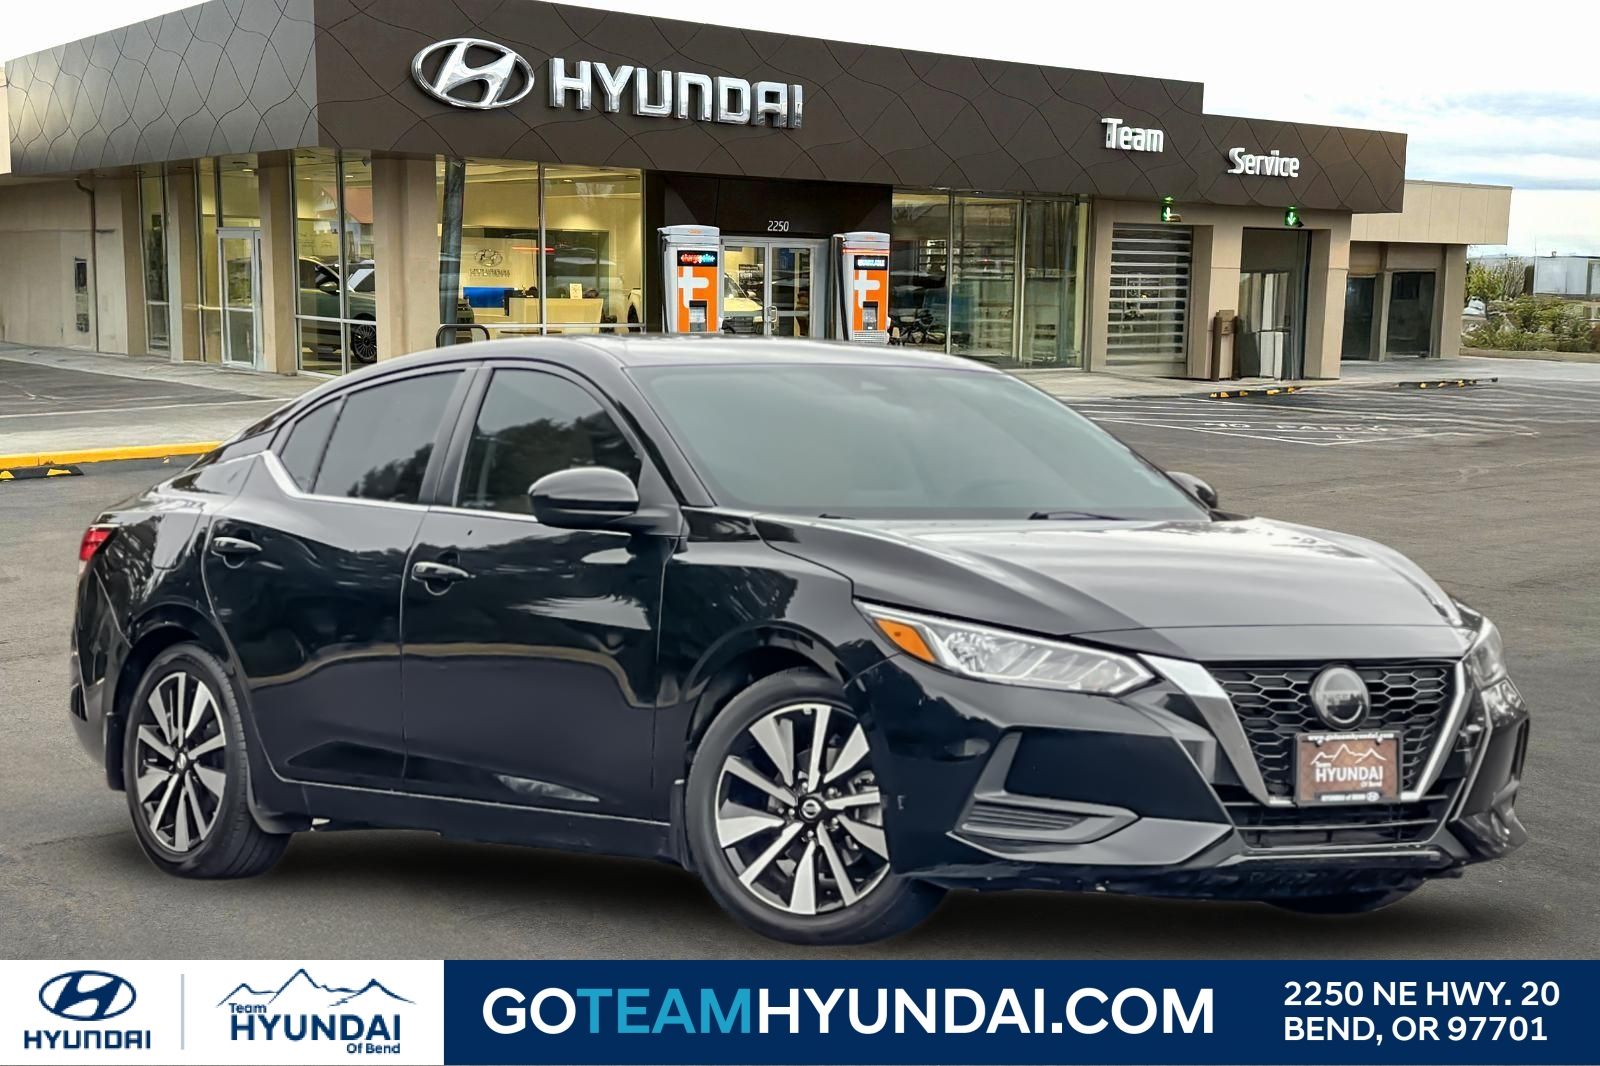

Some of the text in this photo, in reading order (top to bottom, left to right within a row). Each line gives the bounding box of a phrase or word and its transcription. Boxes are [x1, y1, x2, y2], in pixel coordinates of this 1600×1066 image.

[548, 57, 804, 129] HYUNDAI
[1101, 117, 1164, 153] Team
[1227, 147, 1300, 178] Service
[767, 220, 790, 232] 2250
[1315, 766, 1384, 783] HYUNDAI
